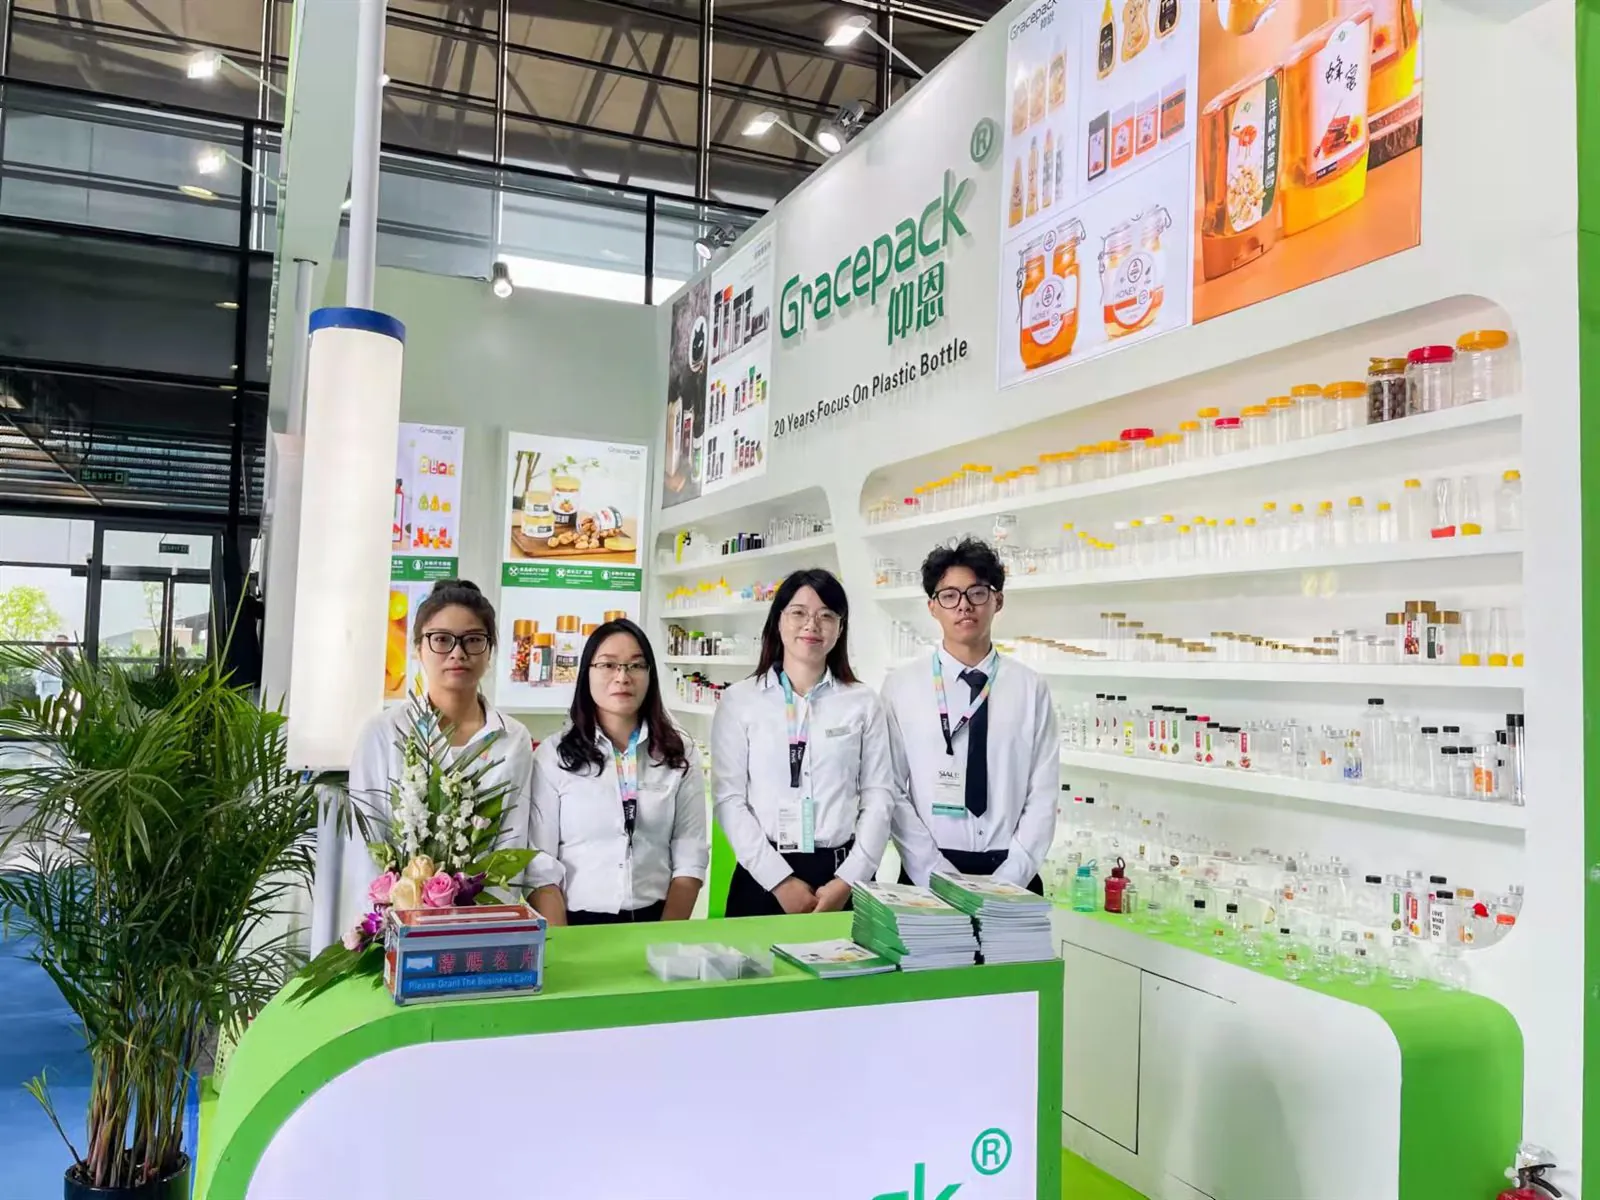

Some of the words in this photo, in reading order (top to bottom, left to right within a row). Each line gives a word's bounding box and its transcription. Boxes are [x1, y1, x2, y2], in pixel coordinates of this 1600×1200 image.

[779, 168, 969, 339] Gracepack
[887, 261, 945, 346] 仰恩
[774, 418, 785, 438] 20
[787, 405, 815, 431] Years
[817, 392, 850, 420] Focus
[853, 383, 869, 405] On
[872, 361, 917, 398] Plastic
[920, 337, 968, 376] Bottle
[408, 980, 436, 990] Please
[462, 977, 475, 986] The
[477, 975, 513, 986] Business
[514, 974, 532, 983] Card
